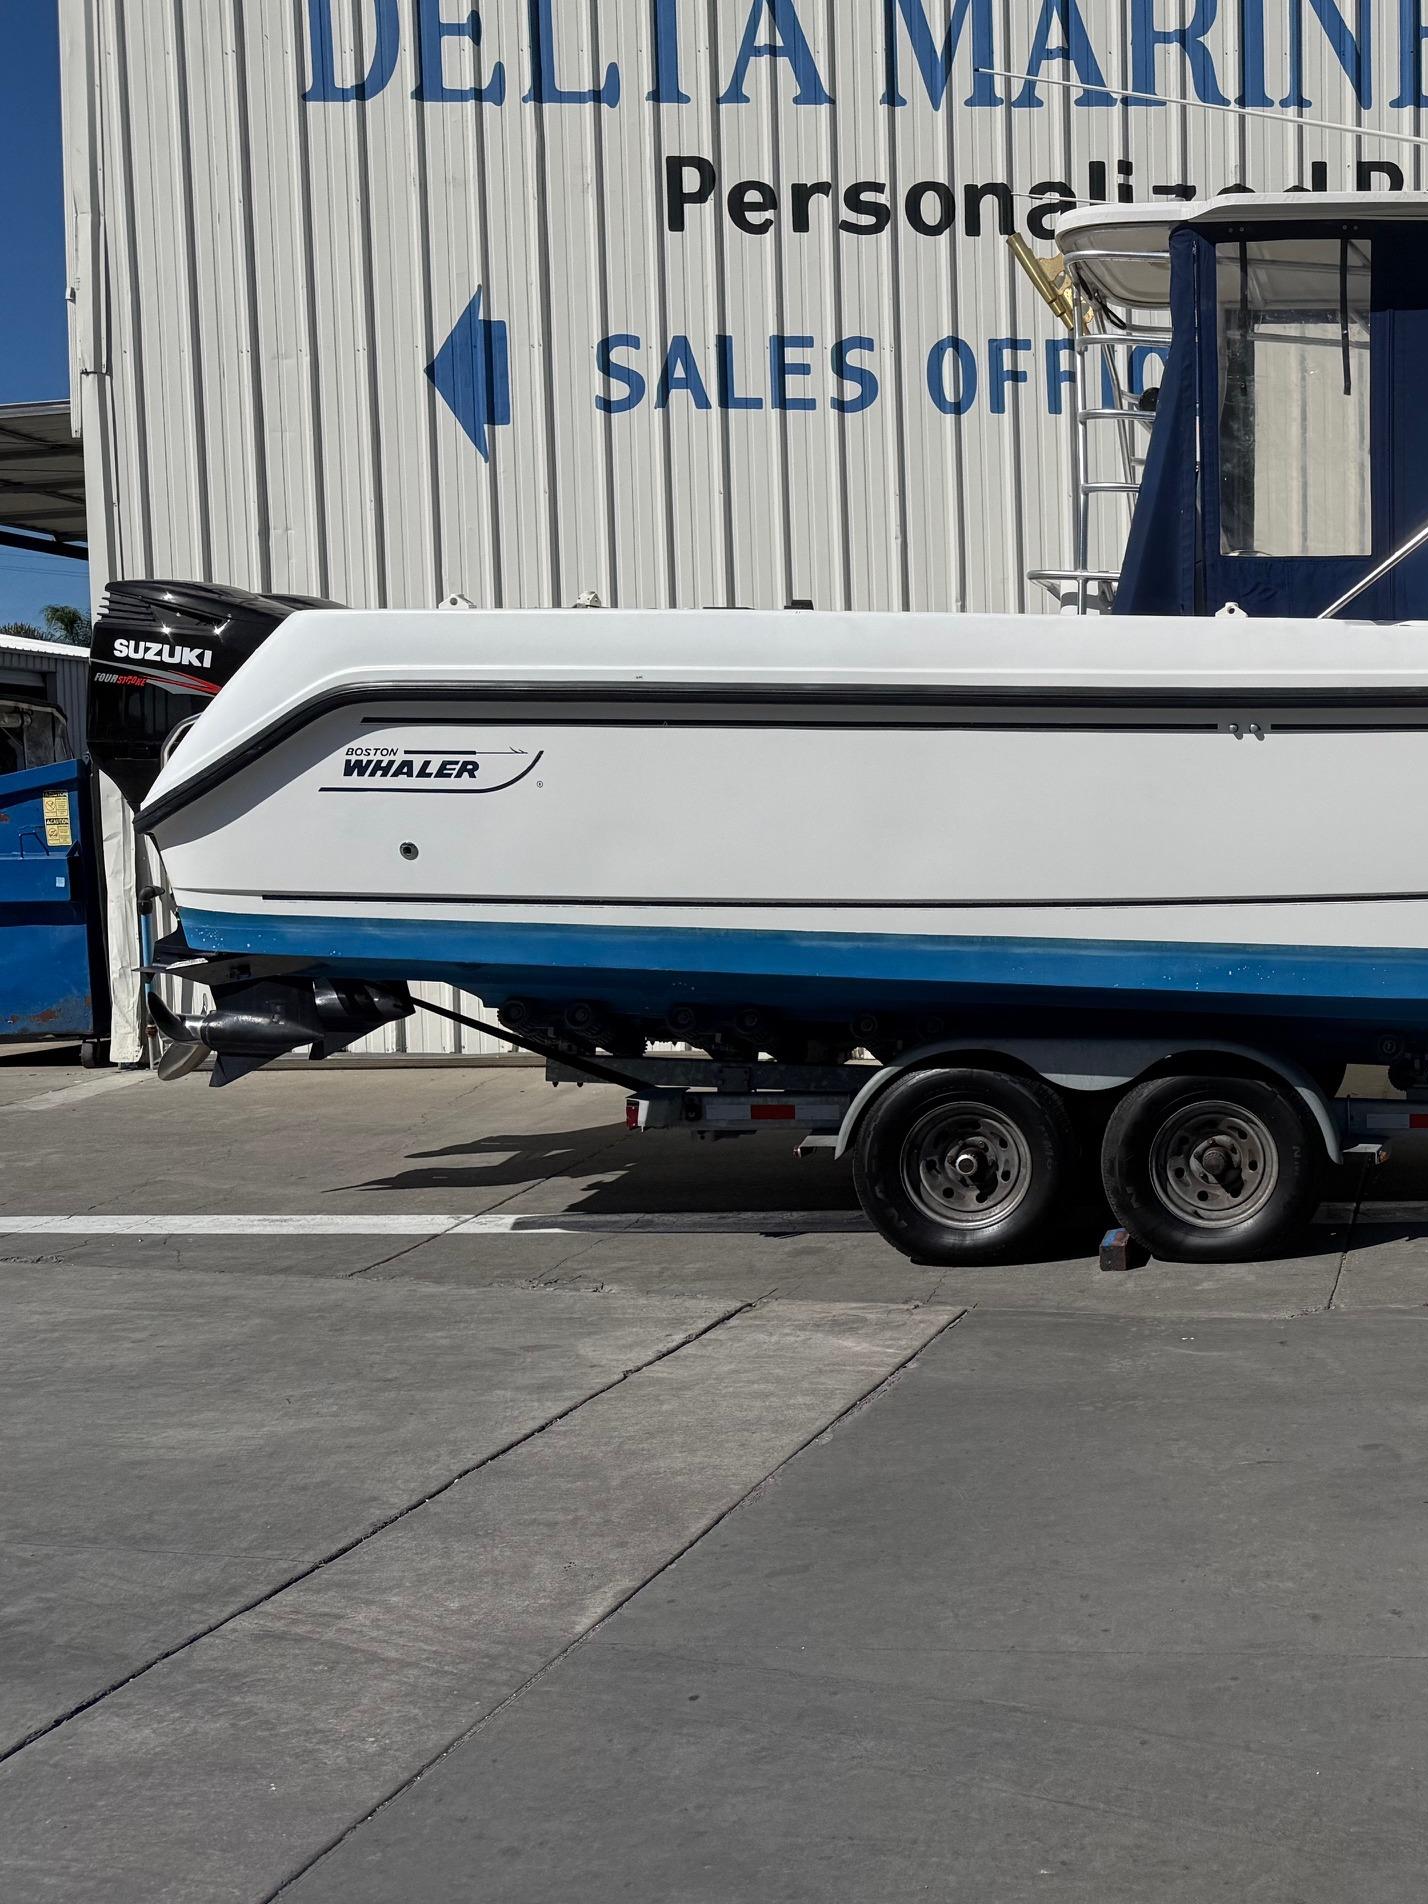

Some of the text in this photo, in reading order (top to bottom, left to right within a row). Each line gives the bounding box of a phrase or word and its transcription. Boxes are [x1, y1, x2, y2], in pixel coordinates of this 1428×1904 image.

[595, 334, 879, 414] SALES
[113, 638, 213, 669] SUZUKI
[345, 747, 399, 757] BOSTON
[343, 759, 480, 779] WHALER
